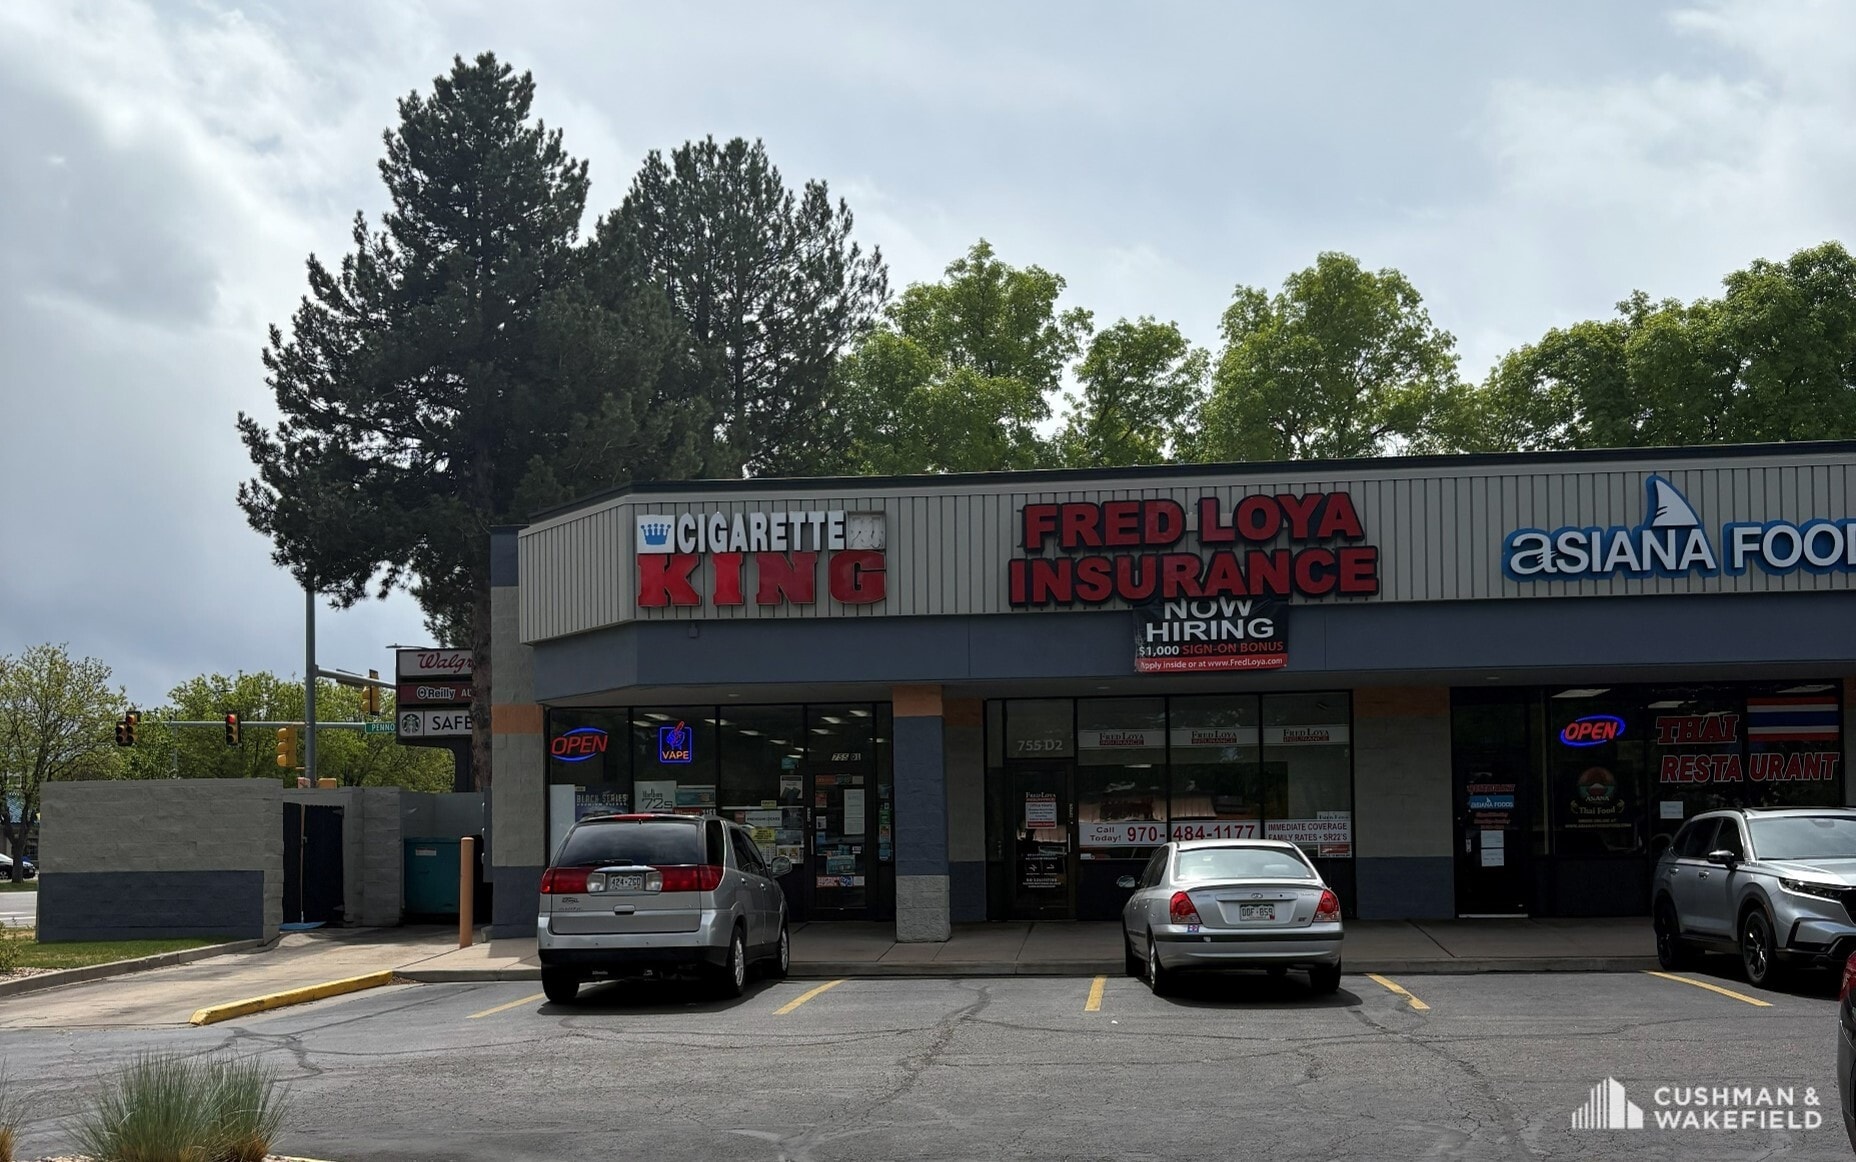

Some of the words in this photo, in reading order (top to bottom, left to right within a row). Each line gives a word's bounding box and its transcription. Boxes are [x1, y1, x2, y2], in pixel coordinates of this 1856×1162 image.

[676, 510, 846, 553] CIGARETTE
[1023, 499, 1185, 549] FRED
[1198, 492, 1364, 543] LOYA
[1733, 523, 1856, 569] FOO
[638, 550, 887, 607] KING
[1009, 546, 1379, 606] INSURANCE
[1164, 597, 1253, 620] NOW
[1146, 617, 1274, 643] HIRING
[1138, 645, 1180, 658] $1,000
[1182, 643, 1237, 655] SIGN-ON
[1240, 641, 1284, 653] BONUS
[1163, 660, 1186, 669] inside
[1198, 660, 1207, 668] at
[1564, 721, 1619, 741] OPEN
[1655, 713, 1740, 745] THAI
[551, 733, 609, 756] OPEN
[662, 750, 689, 761] VAPE
[1096, 826, 1114, 835] Call
[1268, 823, 1306, 831] IMMEDIATE
[1089, 834, 1122, 844] Today!
